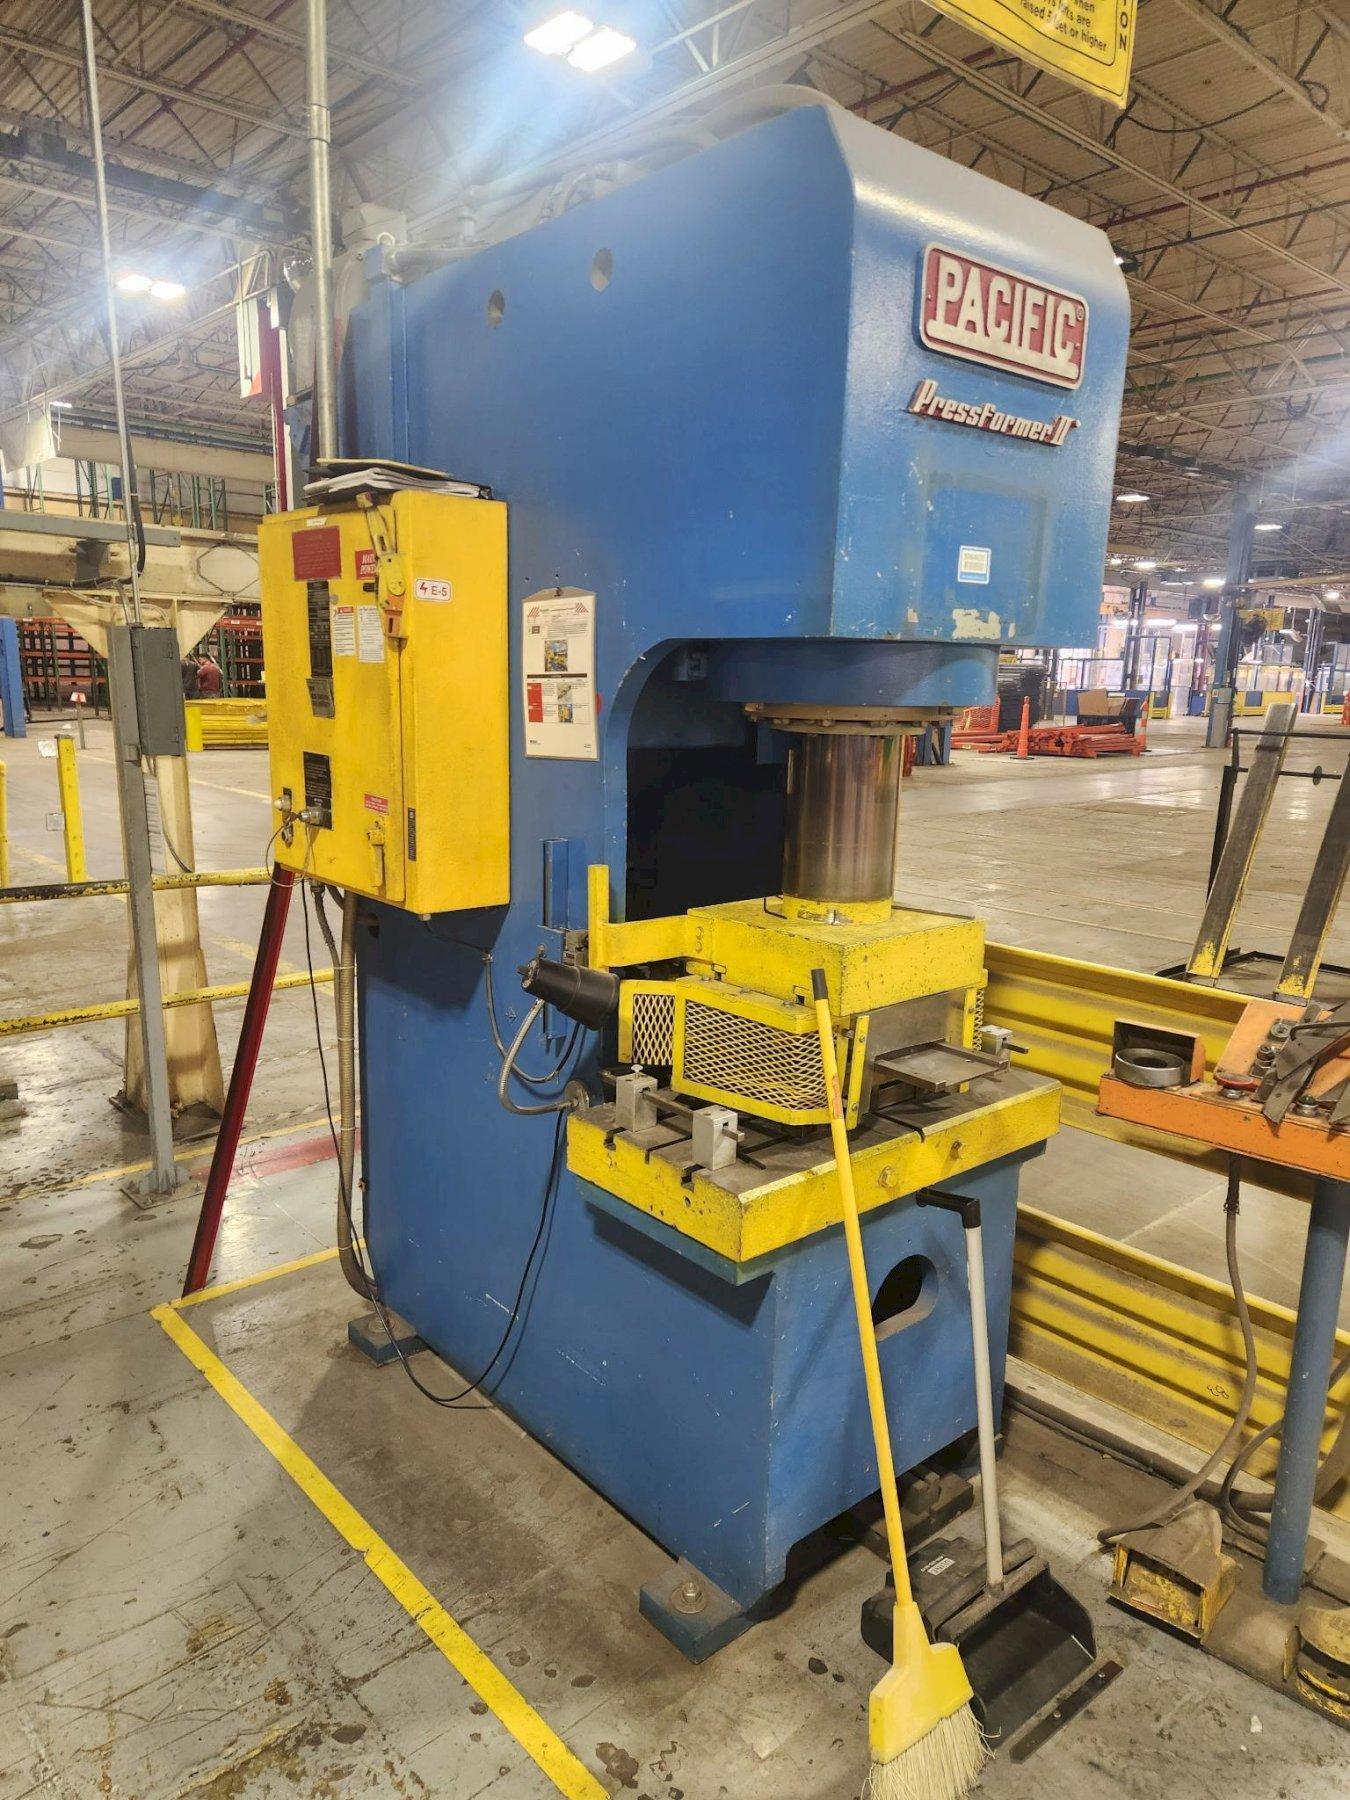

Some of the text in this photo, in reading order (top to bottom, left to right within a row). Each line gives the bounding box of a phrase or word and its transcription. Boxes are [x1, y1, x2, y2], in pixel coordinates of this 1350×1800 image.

[1076, 14, 1092, 28] are
[1070, 27, 1079, 39] or
[1081, 29, 1107, 52] higher
[936, 255, 1076, 365] PACIFIC
[431, 585, 448, 598] E-5
